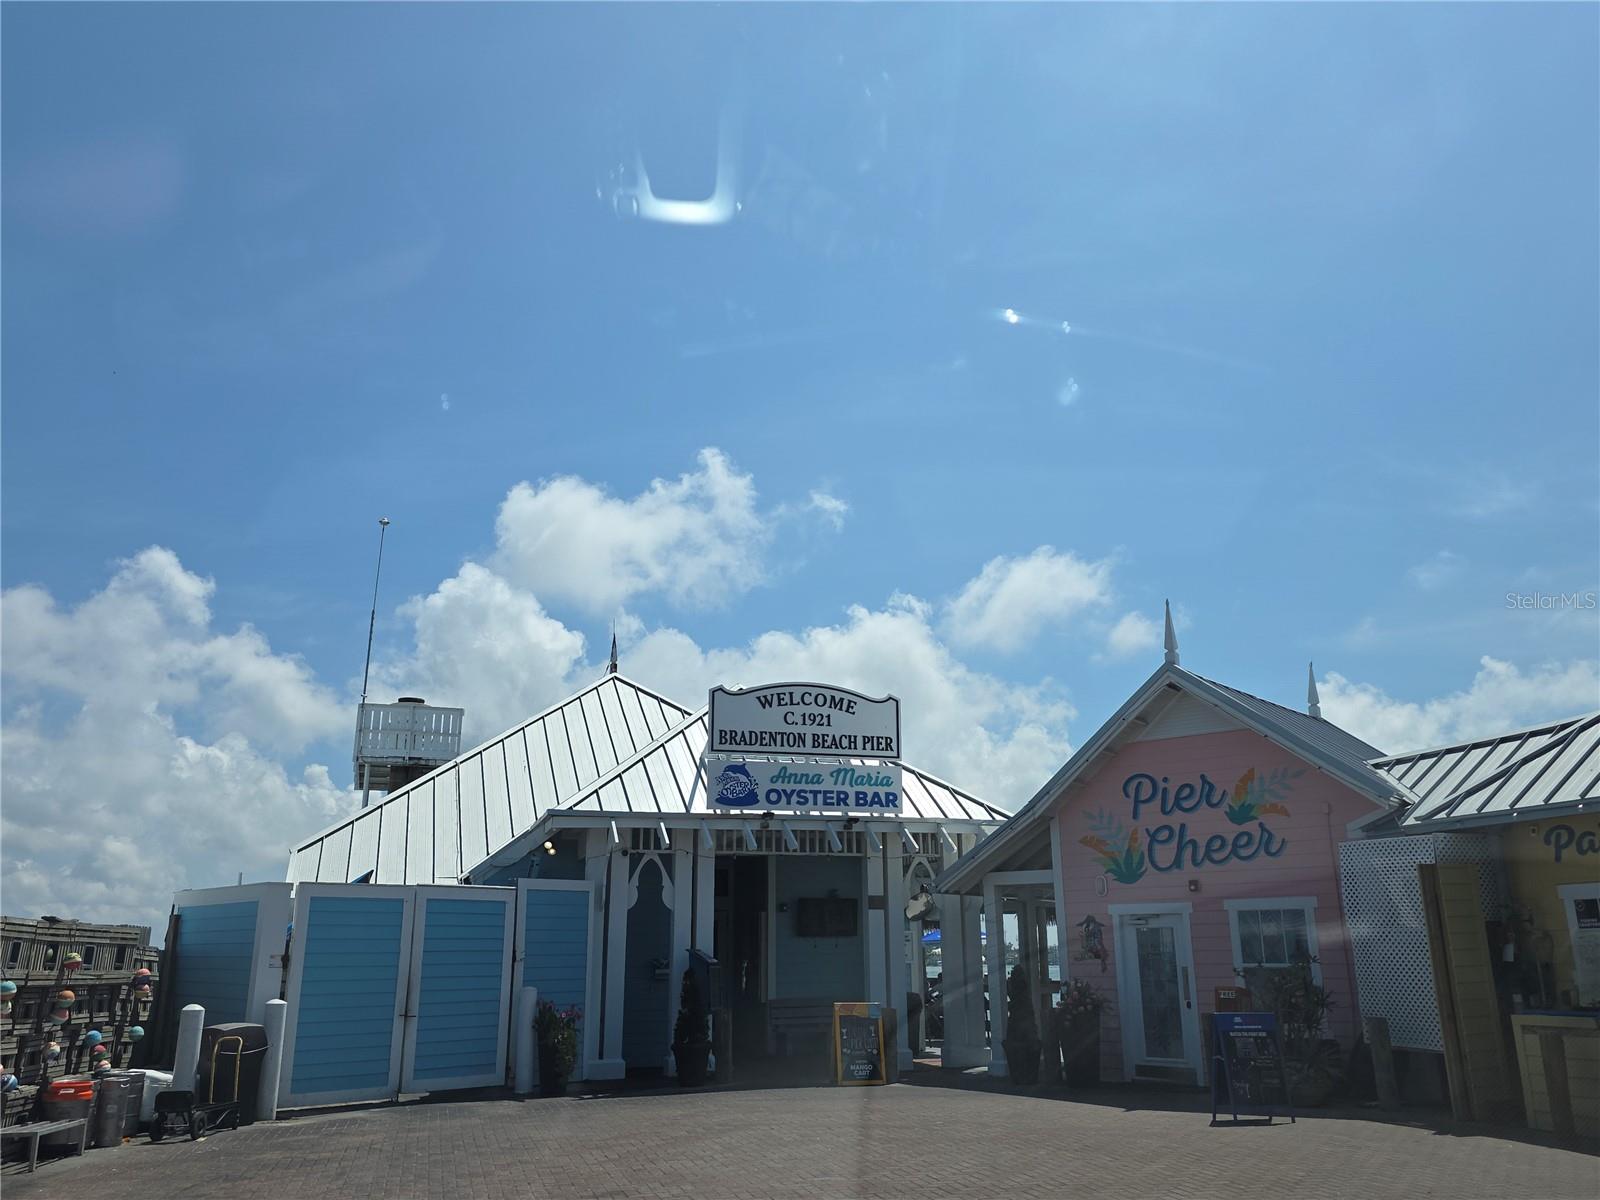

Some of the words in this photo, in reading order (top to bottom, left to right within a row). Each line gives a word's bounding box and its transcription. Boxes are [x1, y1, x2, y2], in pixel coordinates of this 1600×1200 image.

[755, 691, 858, 716] WELCOME
[718, 729, 807, 749] BRADENTON
[811, 733, 858, 750] BEACH
[861, 736, 894, 752] PIER
[769, 766, 825, 786] Anna
[831, 767, 894, 788] Maria
[765, 788, 850, 807] OYSTER
[853, 790, 899, 809] BAR
[1122, 773, 1229, 821] Pier
[1144, 821, 1287, 873] Cheer
